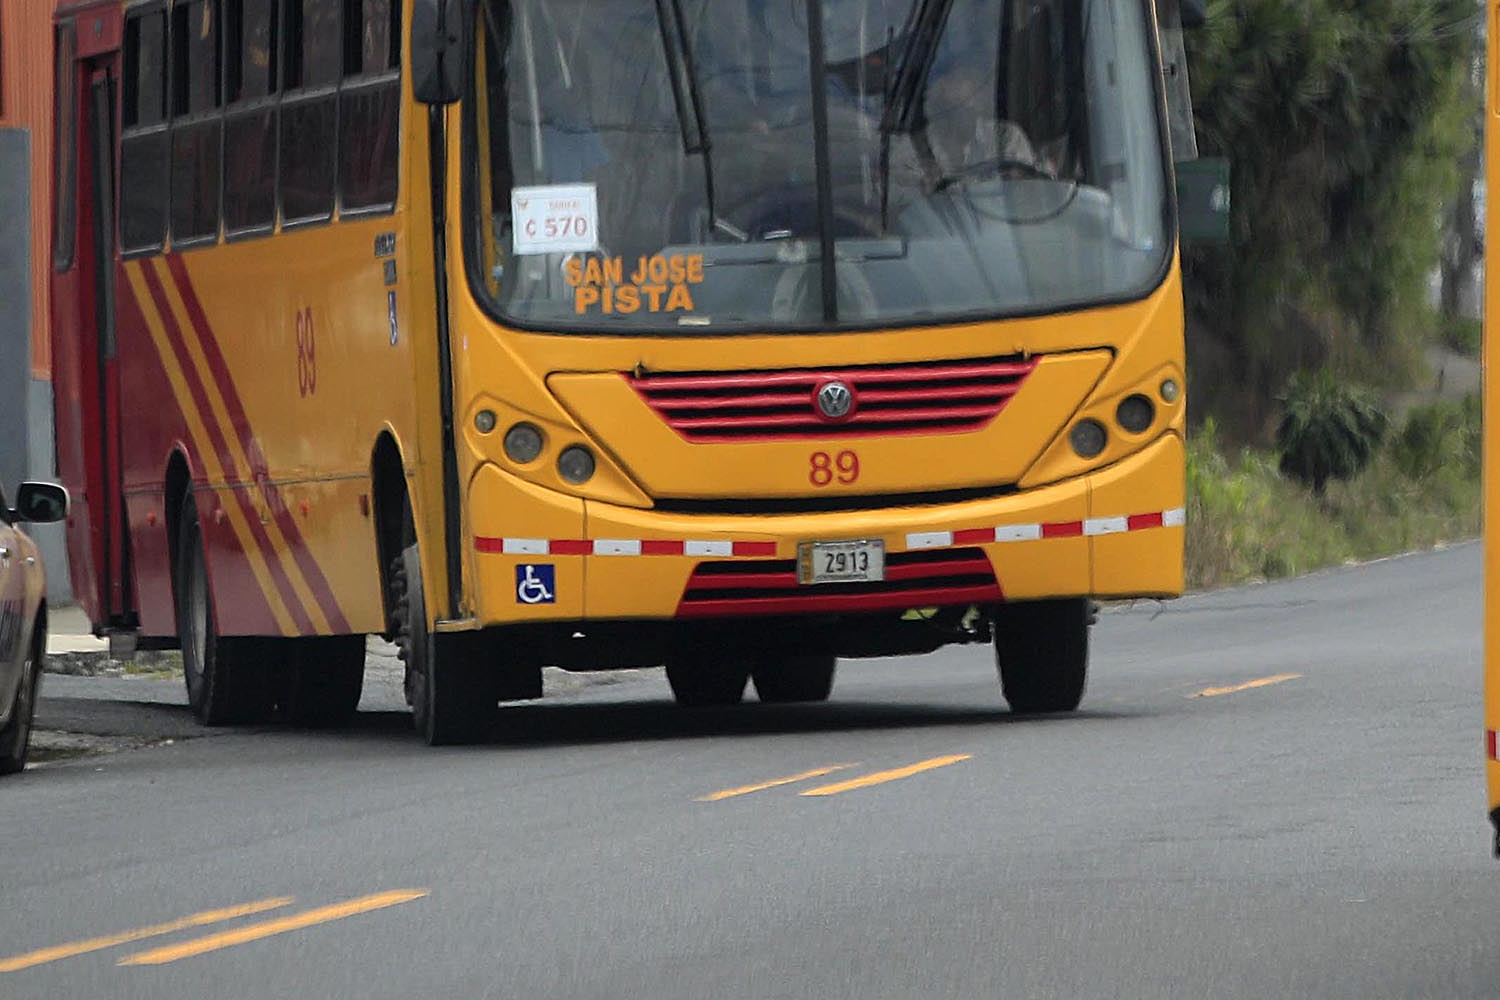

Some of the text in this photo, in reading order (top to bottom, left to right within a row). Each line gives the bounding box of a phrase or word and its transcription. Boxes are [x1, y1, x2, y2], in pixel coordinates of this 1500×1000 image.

[544, 216, 588, 237] 570
[564, 254, 704, 287] SAN JOSE
[574, 284, 694, 315] PISTA
[808, 450, 860, 488] 89
[825, 552, 868, 573] 2913
